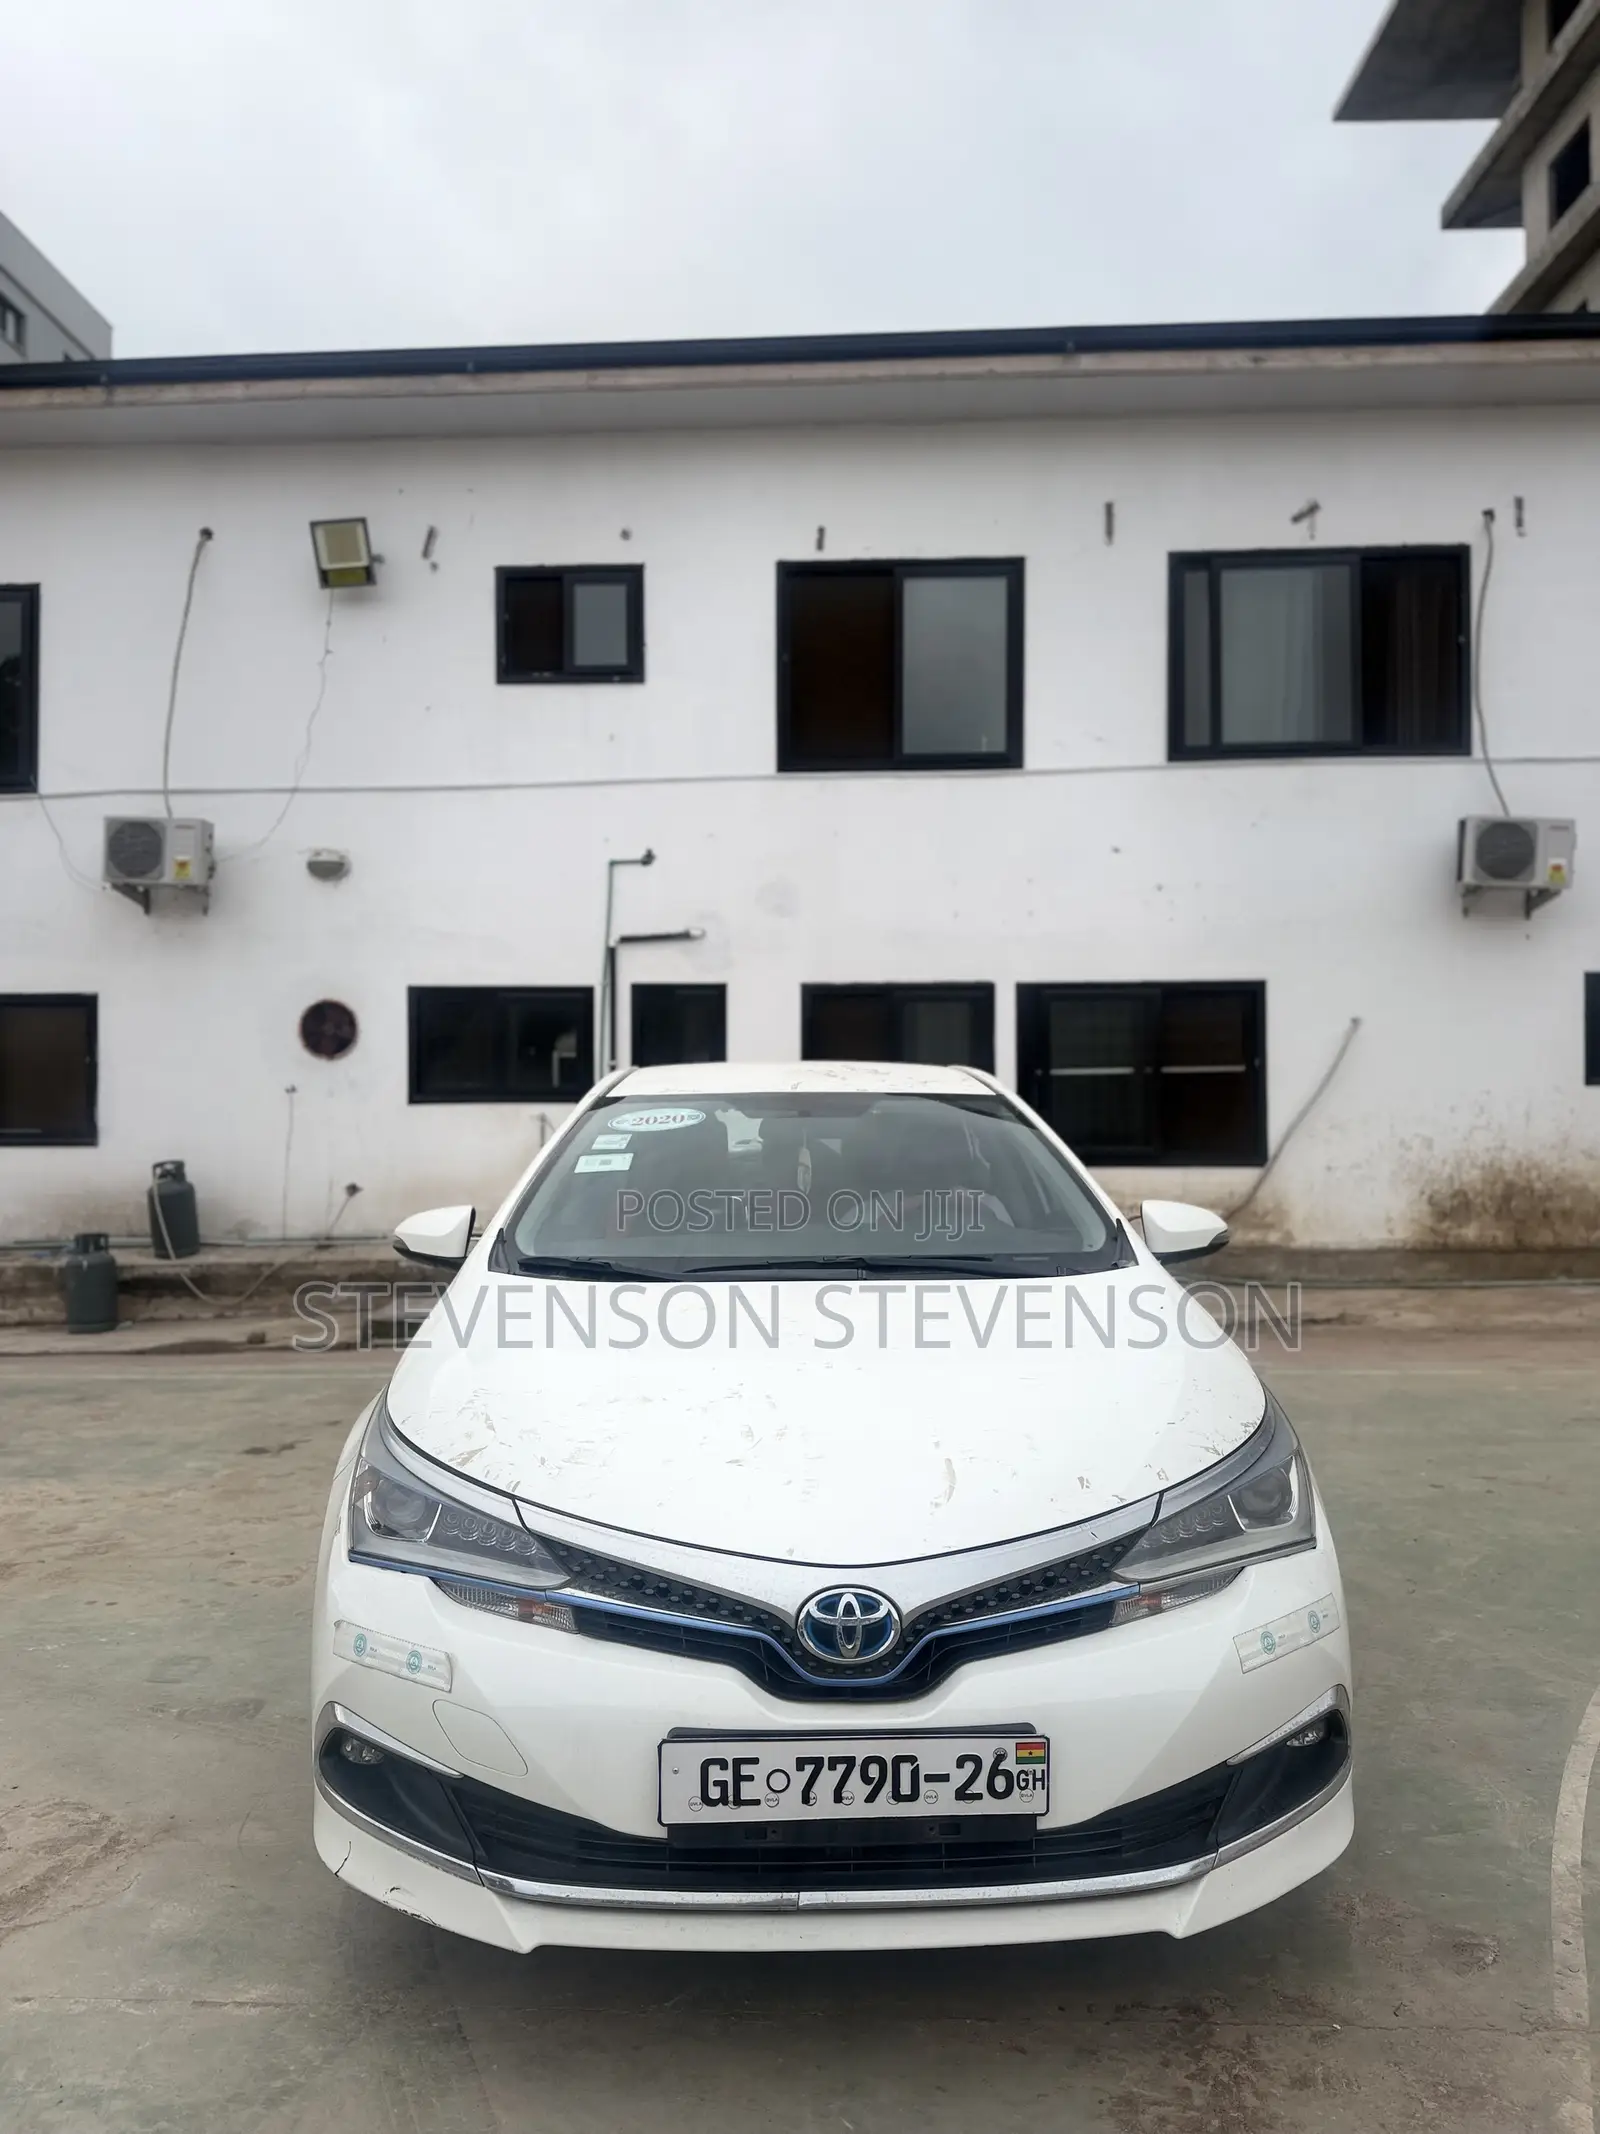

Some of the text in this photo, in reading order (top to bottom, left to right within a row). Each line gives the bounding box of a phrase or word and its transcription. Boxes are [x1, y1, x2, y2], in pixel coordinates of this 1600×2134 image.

[630, 1113, 686, 1127] 2020
[700, 1753, 1014, 1806] GE 7790-26
[1016, 1769, 1045, 1791] GH
